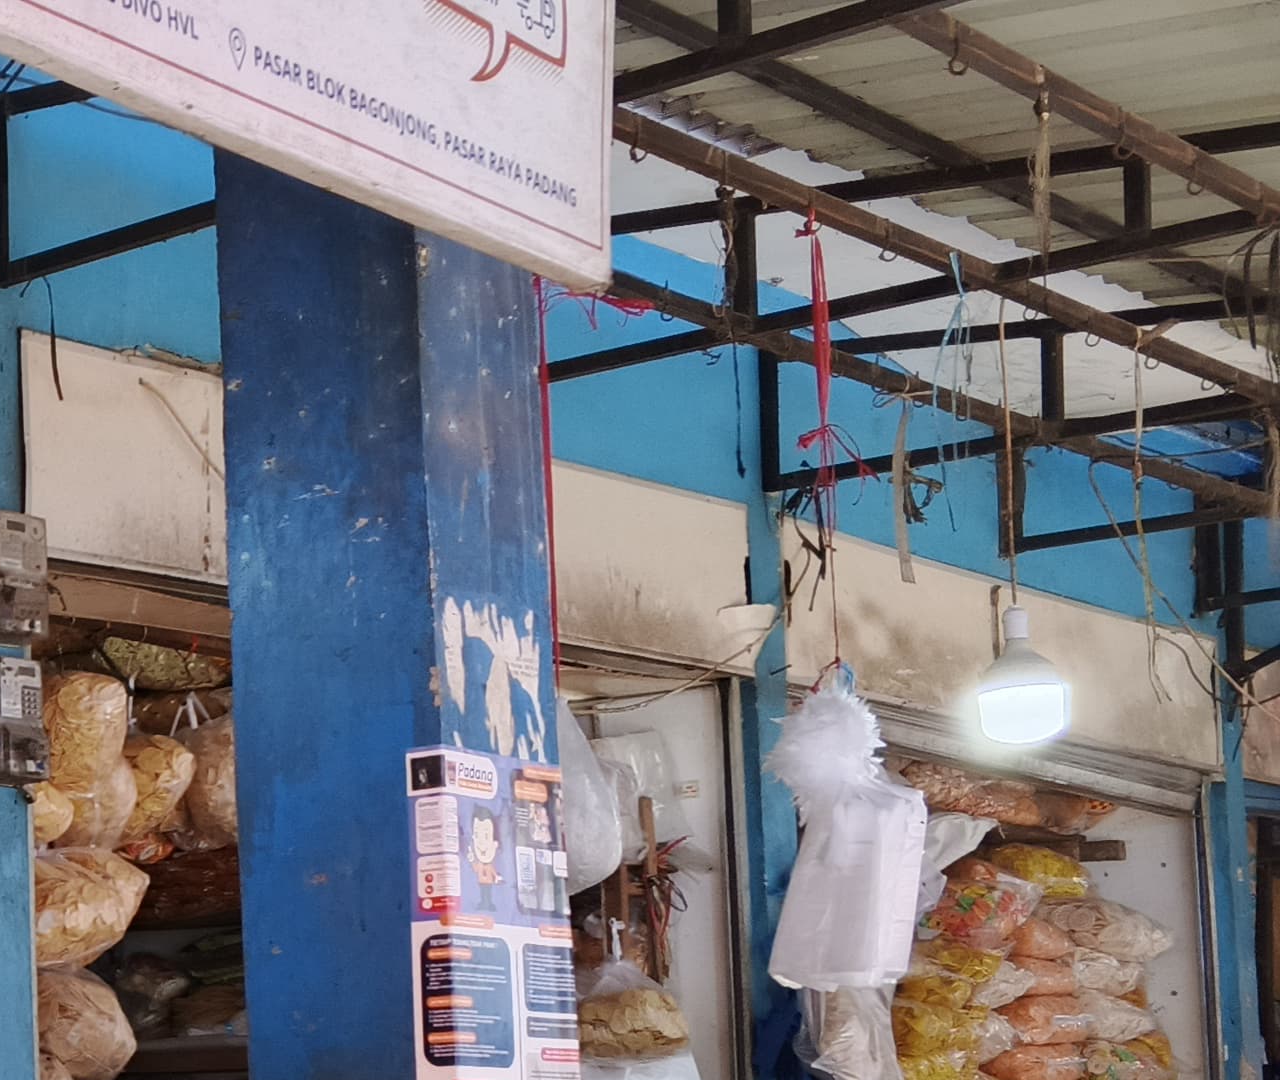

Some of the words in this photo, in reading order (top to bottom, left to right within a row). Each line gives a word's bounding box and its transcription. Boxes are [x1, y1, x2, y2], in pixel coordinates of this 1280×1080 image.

[167, 7, 199, 40] HVL
[254, 45, 303, 85] PASAR
[306, 68, 347, 106] BLOK
[349, 88, 441, 150] BAGONJONG,
[444, 131, 485, 165] PASAR
[489, 151, 523, 183] RAYA
[525, 167, 577, 208] PADANG
[458, 762, 493, 785] Padang
